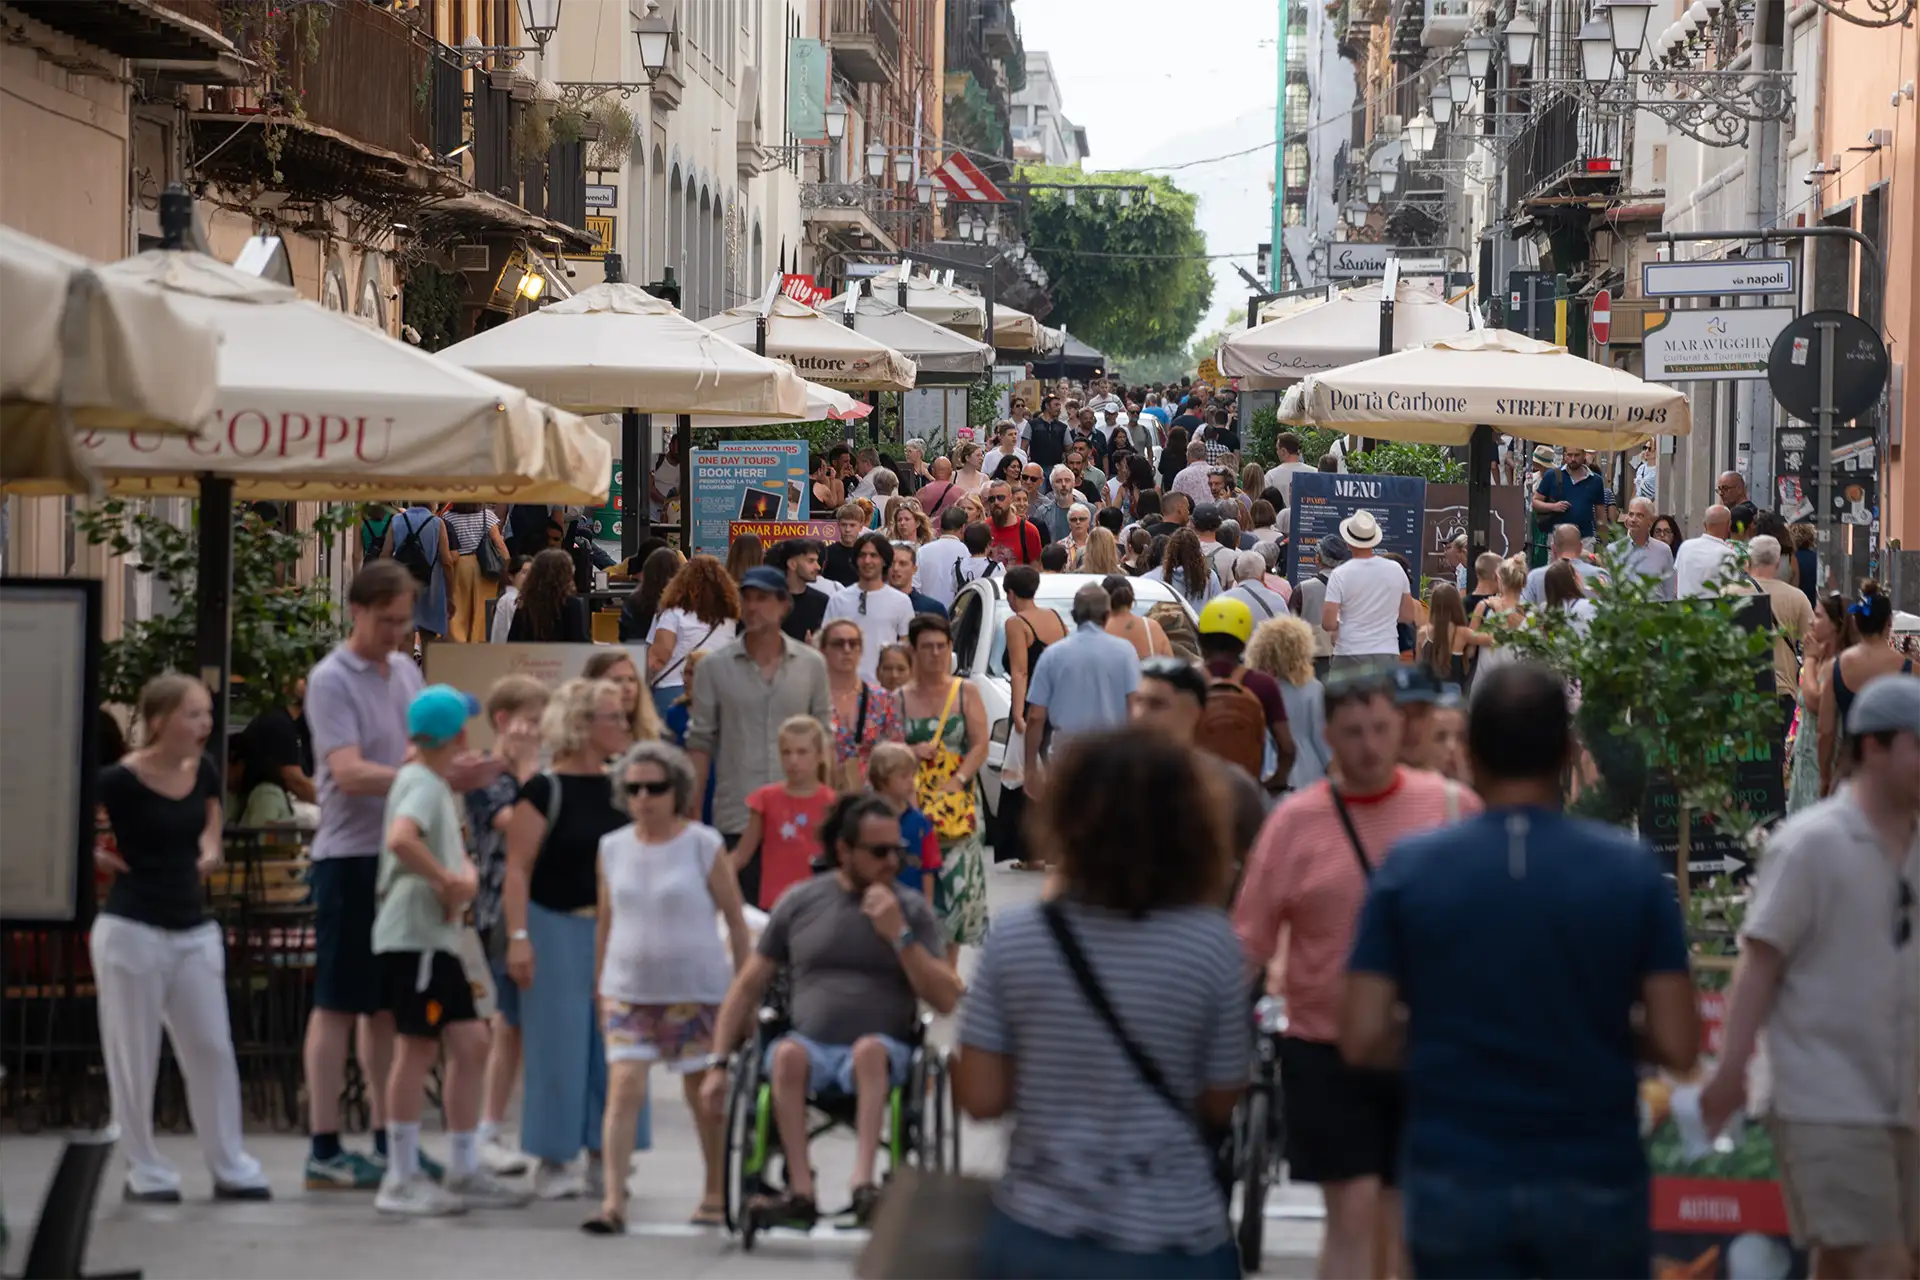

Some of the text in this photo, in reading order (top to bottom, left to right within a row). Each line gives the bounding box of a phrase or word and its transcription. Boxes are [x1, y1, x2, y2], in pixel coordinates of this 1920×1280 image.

[1333, 249, 1386, 271] Laurin
[1746, 273, 1784, 286] napoli
[785, 279, 812, 302] illy
[1387, 390, 1468, 413] Carbone
[1496, 399, 1668, 425] STREET FOOD 1943
[697, 456, 777, 465] ONE DAY TOURS
[699, 468, 767, 478] BOOK HERE!
[1335, 480, 1382, 499] MENU
[732, 525, 771, 537] SONAR
[773, 525, 820, 537] BANGLA
